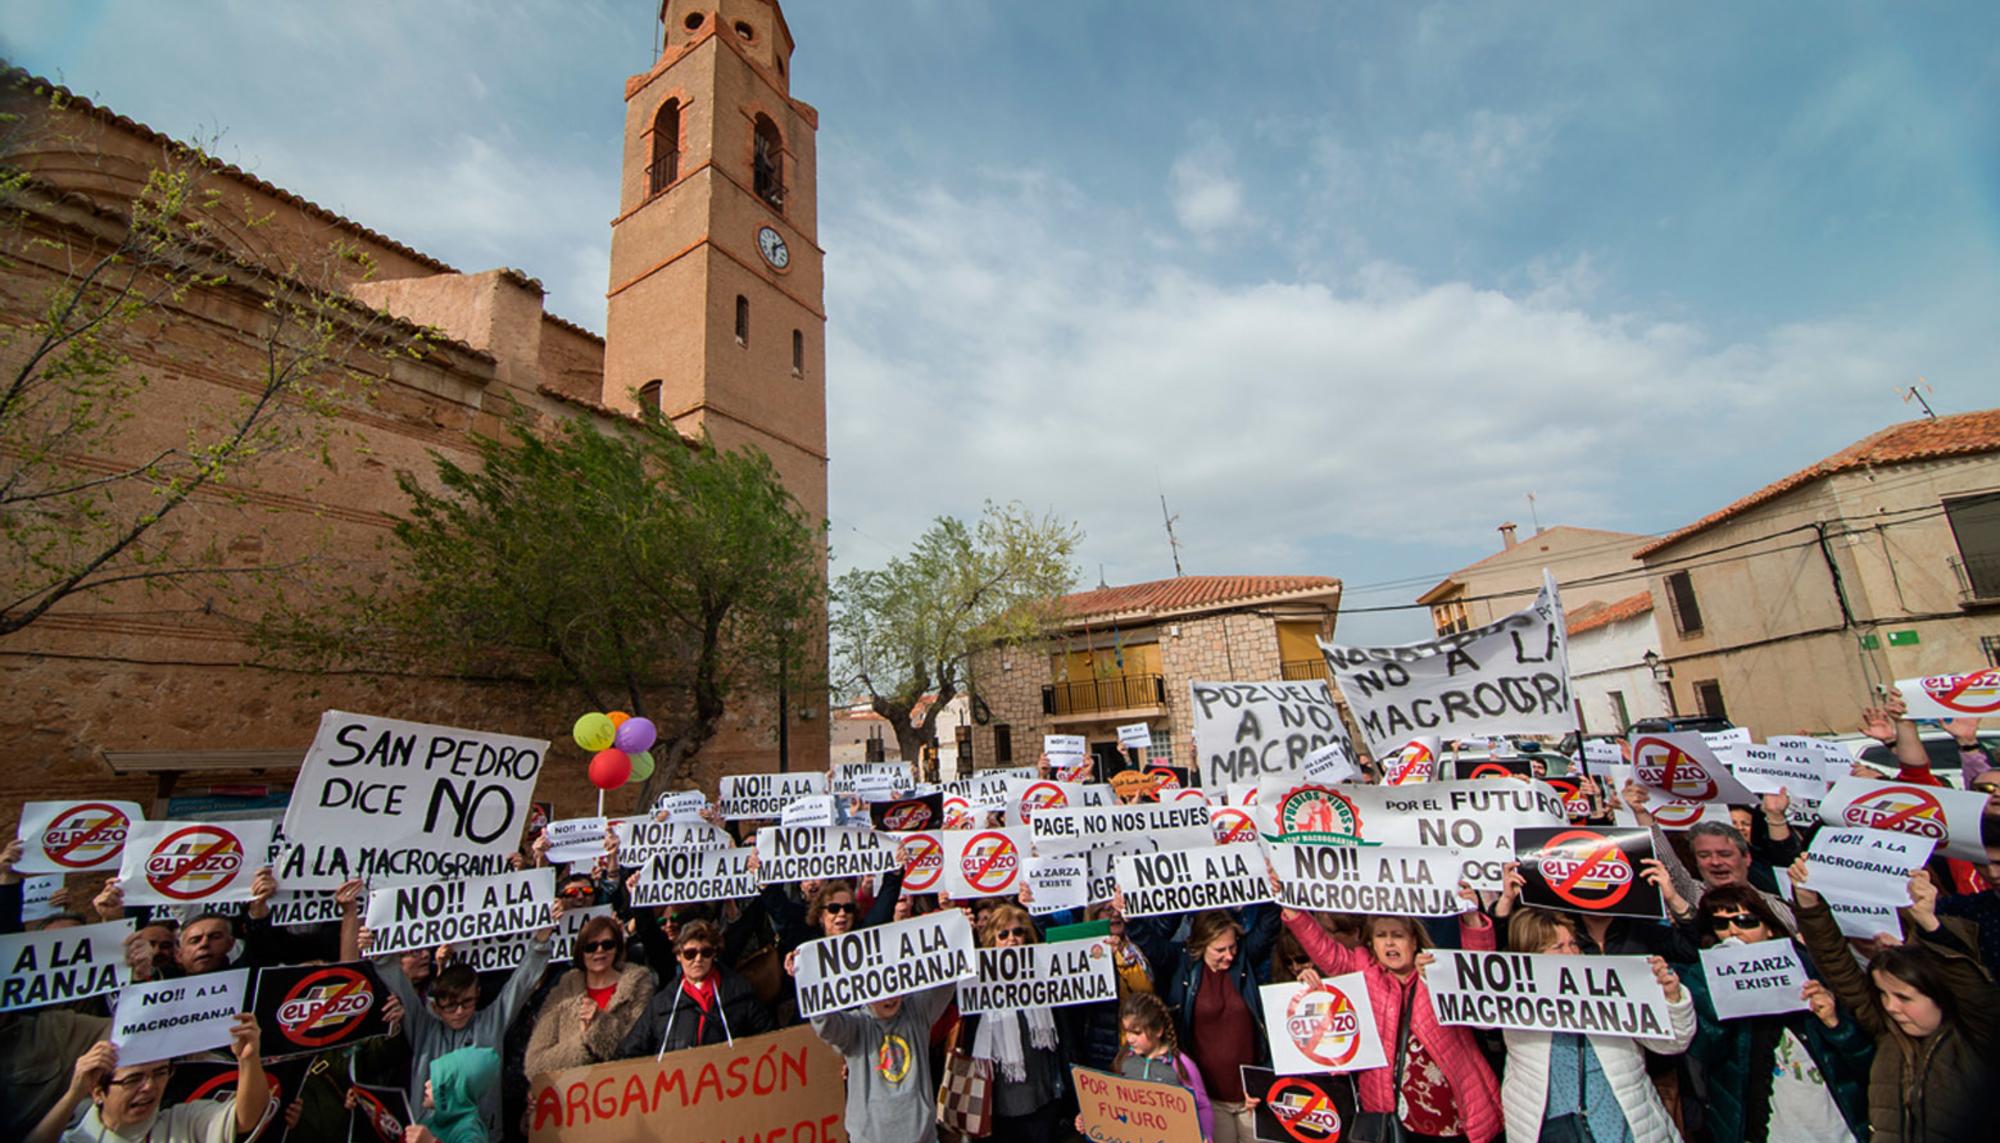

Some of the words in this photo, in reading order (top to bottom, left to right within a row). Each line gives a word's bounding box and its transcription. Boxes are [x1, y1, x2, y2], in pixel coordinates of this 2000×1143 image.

[1355, 663, 1410, 697] NO
[1447, 648, 1480, 676] A
[1236, 710, 1262, 743] A
[1278, 704, 1334, 732] NO
[328, 724, 417, 768] SAN
[425, 736, 539, 780] PEDRO
[1747, 750, 1776, 760] NO!!
[1795, 756, 1810, 764] LA
[1780, 741, 1807, 749] NO!!
[733, 776, 772, 798] NO!!
[782, 780, 791, 795] A
[795, 779, 812, 795] LA
[981, 782, 989, 797] A
[991, 779, 1007, 794] LA
[1739, 766, 1822, 781] MACROGRANJA
[319, 777, 406, 815] DICE
[423, 777, 515, 844] NO
[1084, 792, 1103, 807] LA
[1386, 801, 1419, 811] POR
[1426, 800, 1442, 810] EL
[1451, 790, 1564, 819] FUTURO
[554, 824, 576, 835] NO!!
[631, 823, 675, 846] NO!!
[684, 828, 694, 844] A
[698, 828, 716, 843] LA
[1034, 816, 1080, 838] PAGE,
[1084, 814, 1107, 834] NO
[1112, 812, 1145, 833] NOS
[1150, 806, 1209, 830] LLEVES
[1418, 818, 1483, 847] NO
[1496, 835, 1510, 849] A
[774, 827, 826, 856] NO!!
[839, 832, 852, 851] A
[858, 832, 879, 850] LA
[1829, 834, 1864, 846] NO!!
[1872, 840, 1882, 849] A
[1886, 842, 1907, 853] LA
[282, 843, 305, 879] A
[313, 846, 349, 880] LA
[359, 848, 515, 880] MACROGRANJA
[653, 852, 704, 881] NO!!
[716, 857, 728, 876] A
[1029, 870, 1042, 879] LA
[1044, 867, 1081, 878] ZARZA
[1134, 852, 1192, 887] NO!!
[1206, 857, 1220, 879] A
[1222, 854, 1249, 877] LA
[1294, 846, 1360, 881] NO!!
[1379, 858, 1396, 883] A
[1401, 859, 1434, 885] LA
[1808, 852, 1911, 878] MACROGRANJA
[635, 877, 759, 905] MACROGRANJ
[1039, 879, 1072, 889] EXISTE
[1124, 877, 1271, 915] MACROGRANJA
[396, 881, 466, 922] NO!!
[483, 886, 498, 909] A
[506, 880, 534, 906] LA
[372, 903, 552, 953] MACROGRANJA
[13, 945, 38, 974] A
[50, 938, 93, 968] LA
[817, 929, 883, 978] NO!!
[899, 932, 915, 959] A
[921, 925, 948, 951] LA
[980, 947, 1034, 983] NO!!
[1050, 954, 1061, 976] A
[1067, 950, 1090, 974] LA
[1716, 965, 1737, 977] LA
[1738, 955, 1796, 974] ZARZA
[1454, 953, 1537, 993] NO!!
[1559, 967, 1579, 995] A
[1584, 968, 1627, 998] LA
[1735, 975, 1791, 991] EXISTE
[142, 988, 186, 1006] NO!!
[196, 987, 207, 998] A
[211, 984, 228, 995] LA
[122, 1006, 236, 1036] MACROGRANJA
[534, 1044, 808, 1131] ARGAMASÓN
[1080, 1073, 1110, 1096] POR
[1116, 1085, 1188, 1114] NUESTRO
[1099, 1102, 1168, 1131] FUTURO
